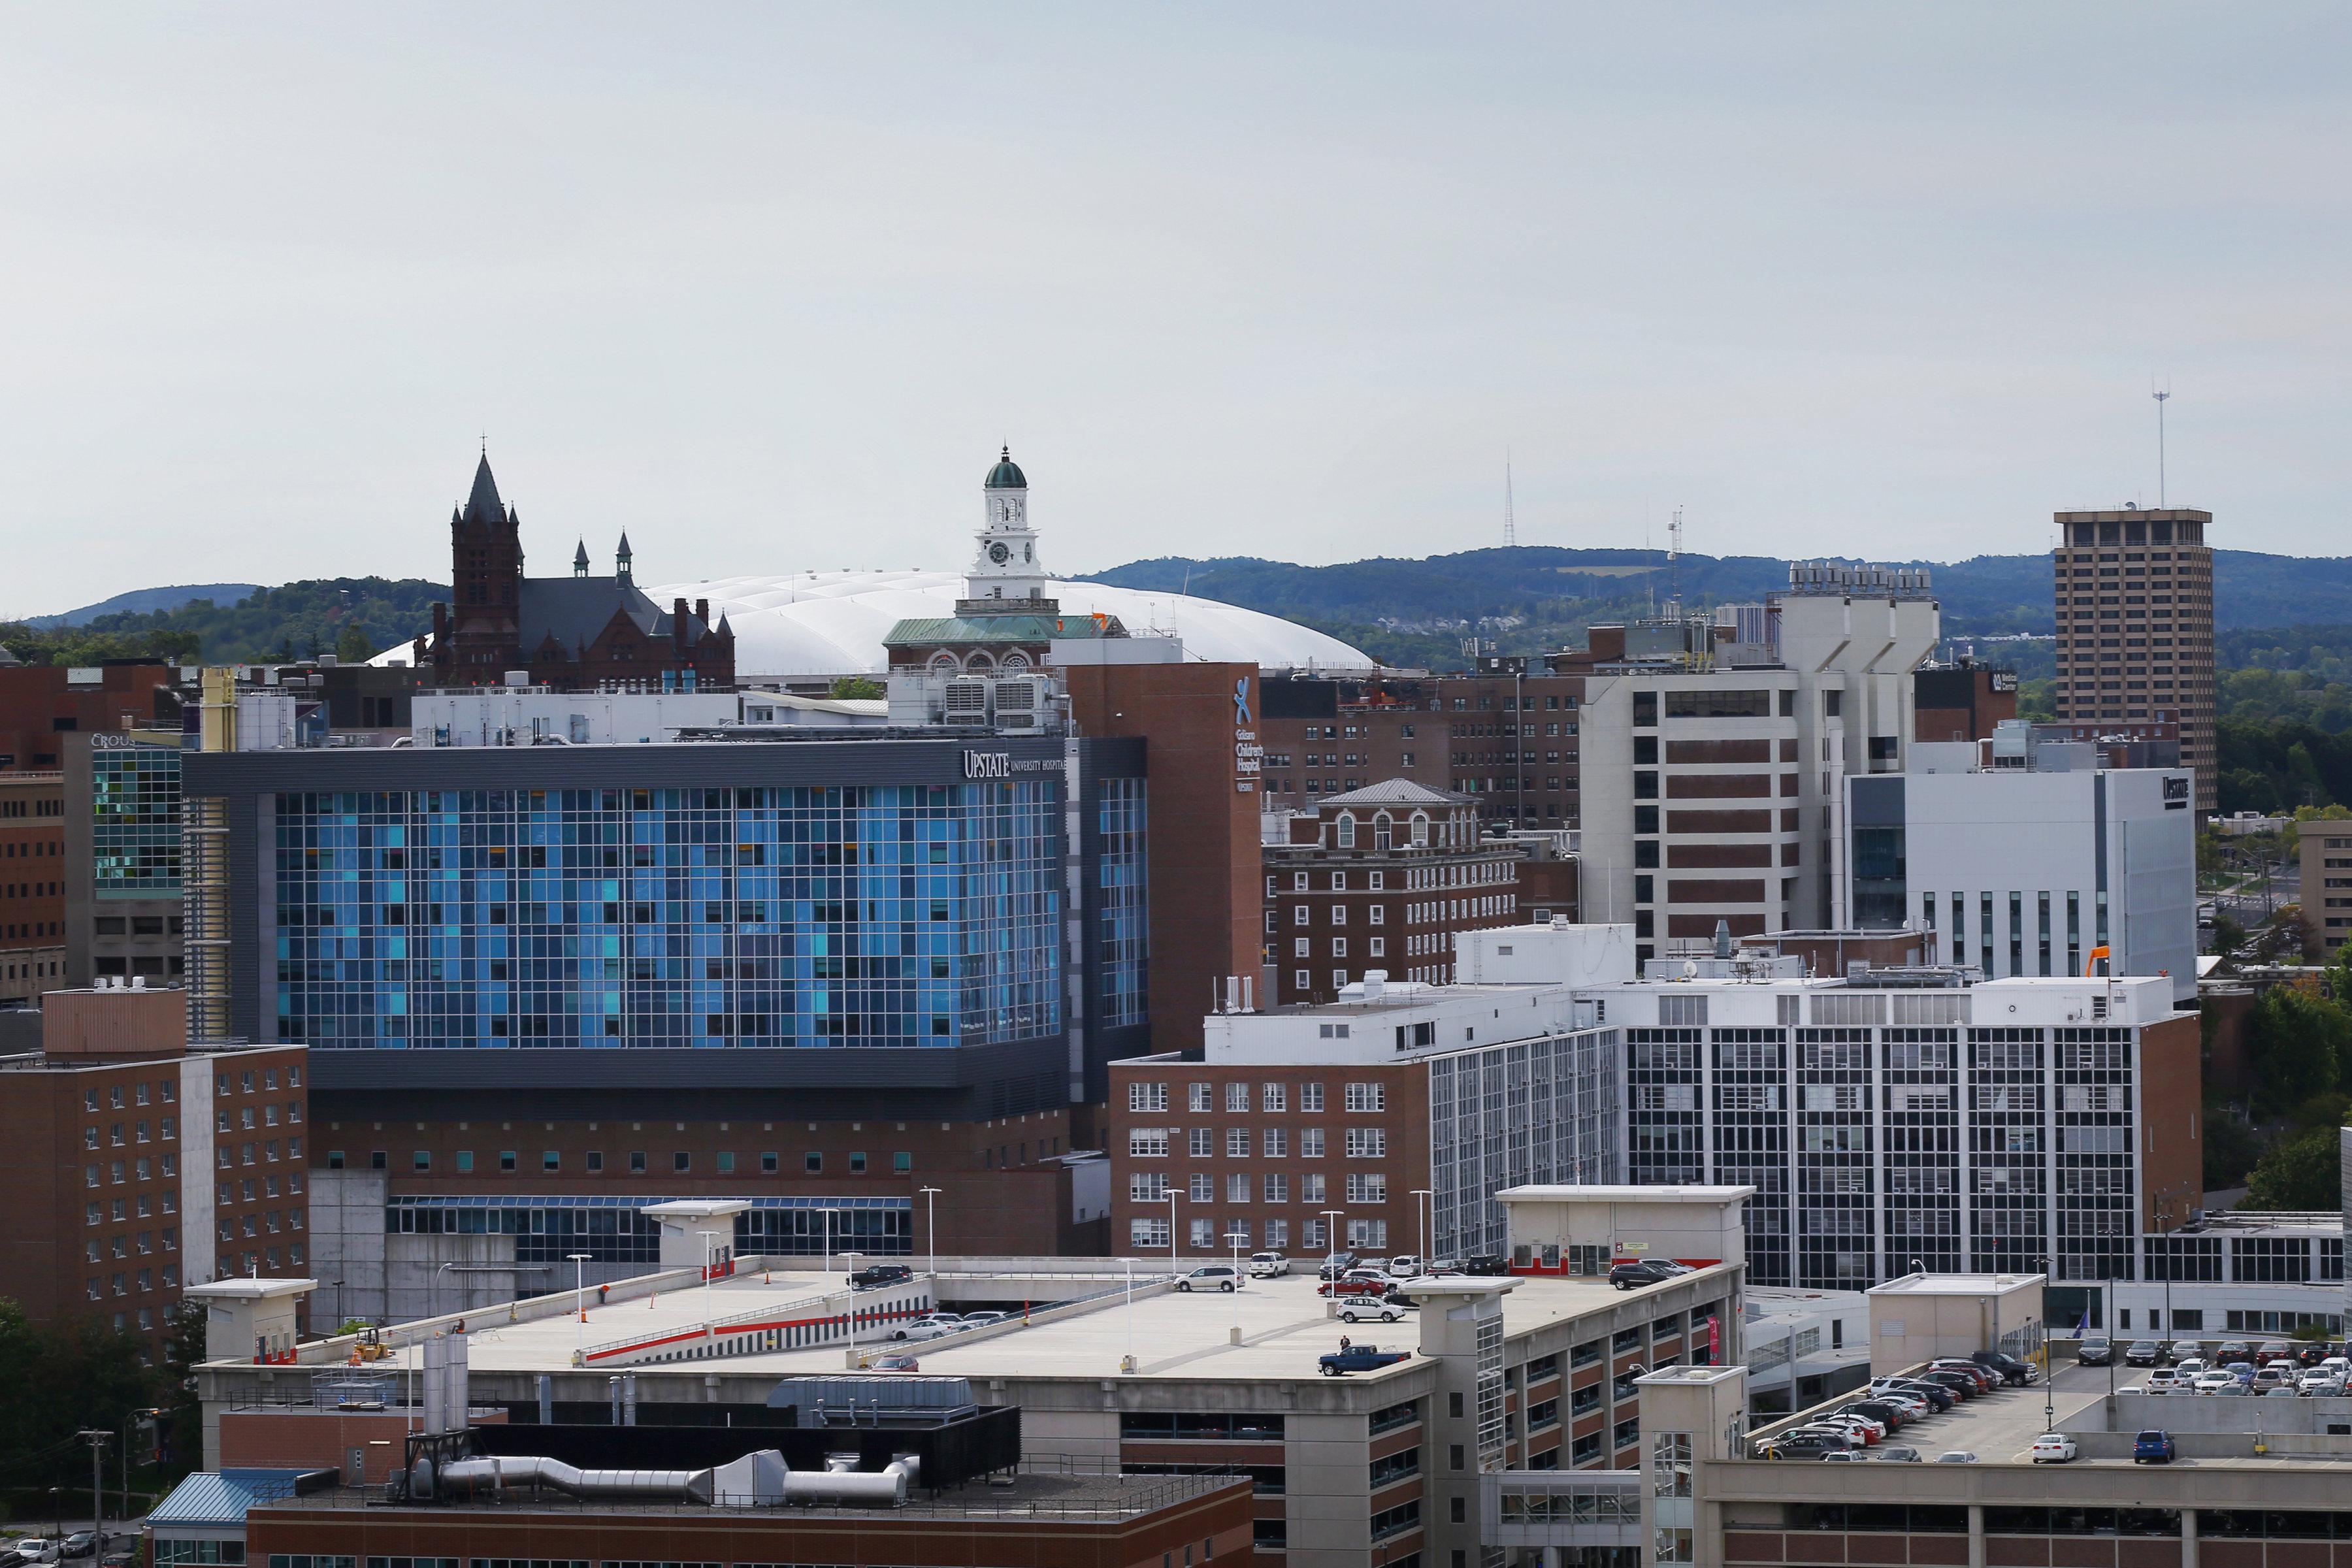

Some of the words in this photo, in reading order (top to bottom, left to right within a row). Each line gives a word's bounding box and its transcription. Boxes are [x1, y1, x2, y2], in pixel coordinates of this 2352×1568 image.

[964, 750, 1010, 778] UPSTATE
[1011, 760, 1041, 771] UNIVERSITY
[2163, 777, 2189, 800] UPSTATE
